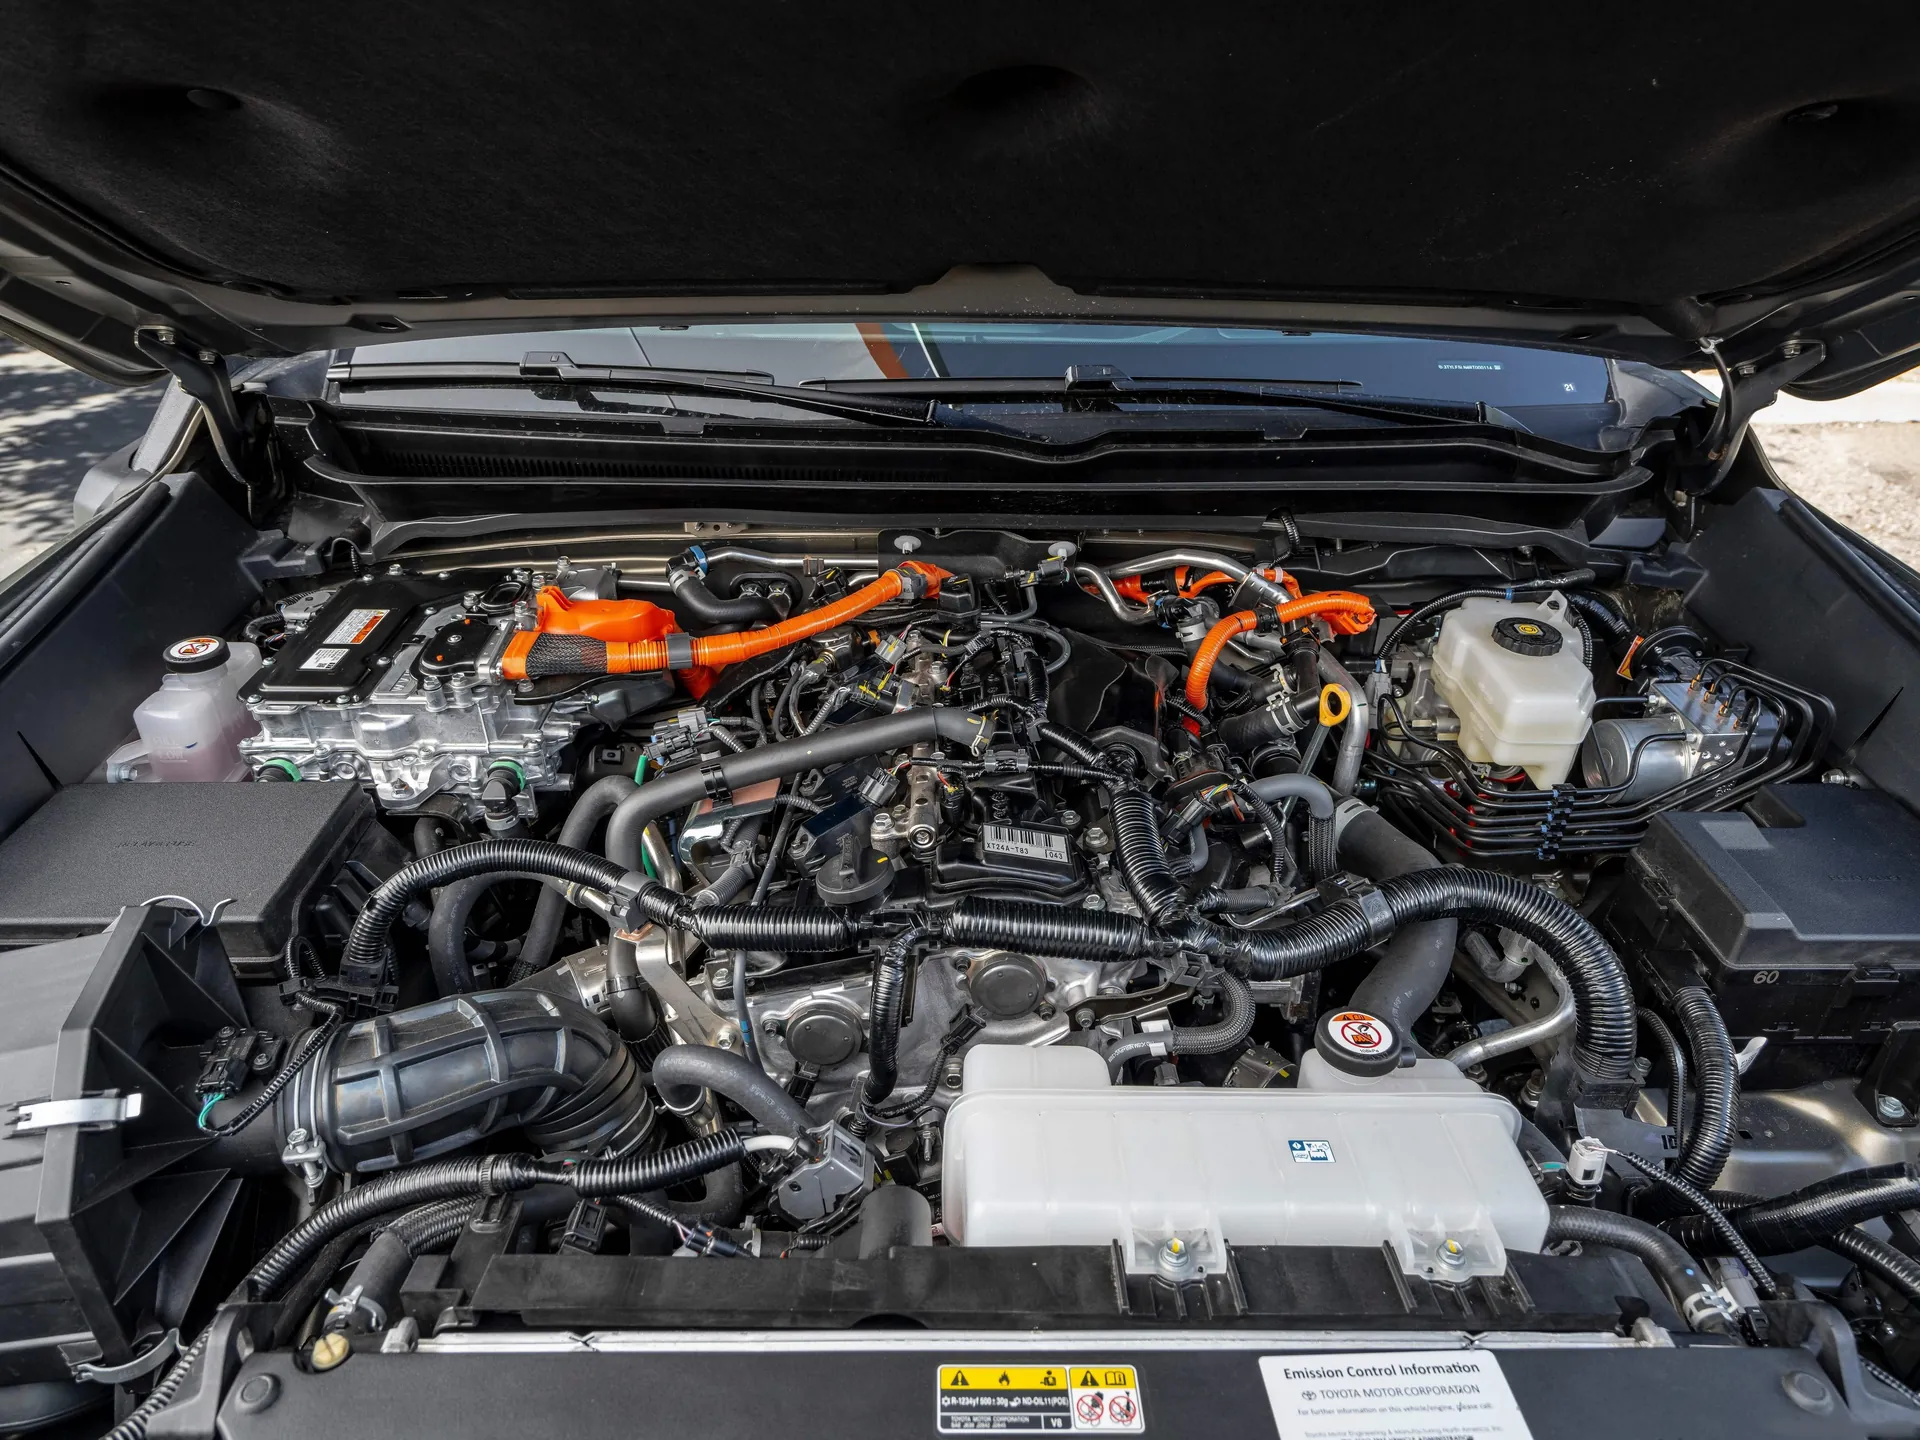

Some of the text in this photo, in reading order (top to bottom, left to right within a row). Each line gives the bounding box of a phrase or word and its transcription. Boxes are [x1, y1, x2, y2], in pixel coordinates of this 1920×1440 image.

[986, 842, 1029, 855] XT24A-T83
[1049, 851, 1064, 860] 043
[1753, 970, 1780, 984] 60
[1283, 1362, 1481, 1380] Emission Control Information
[1319, 1384, 1481, 1399] TOYOTA MOTOR CORPORATION
